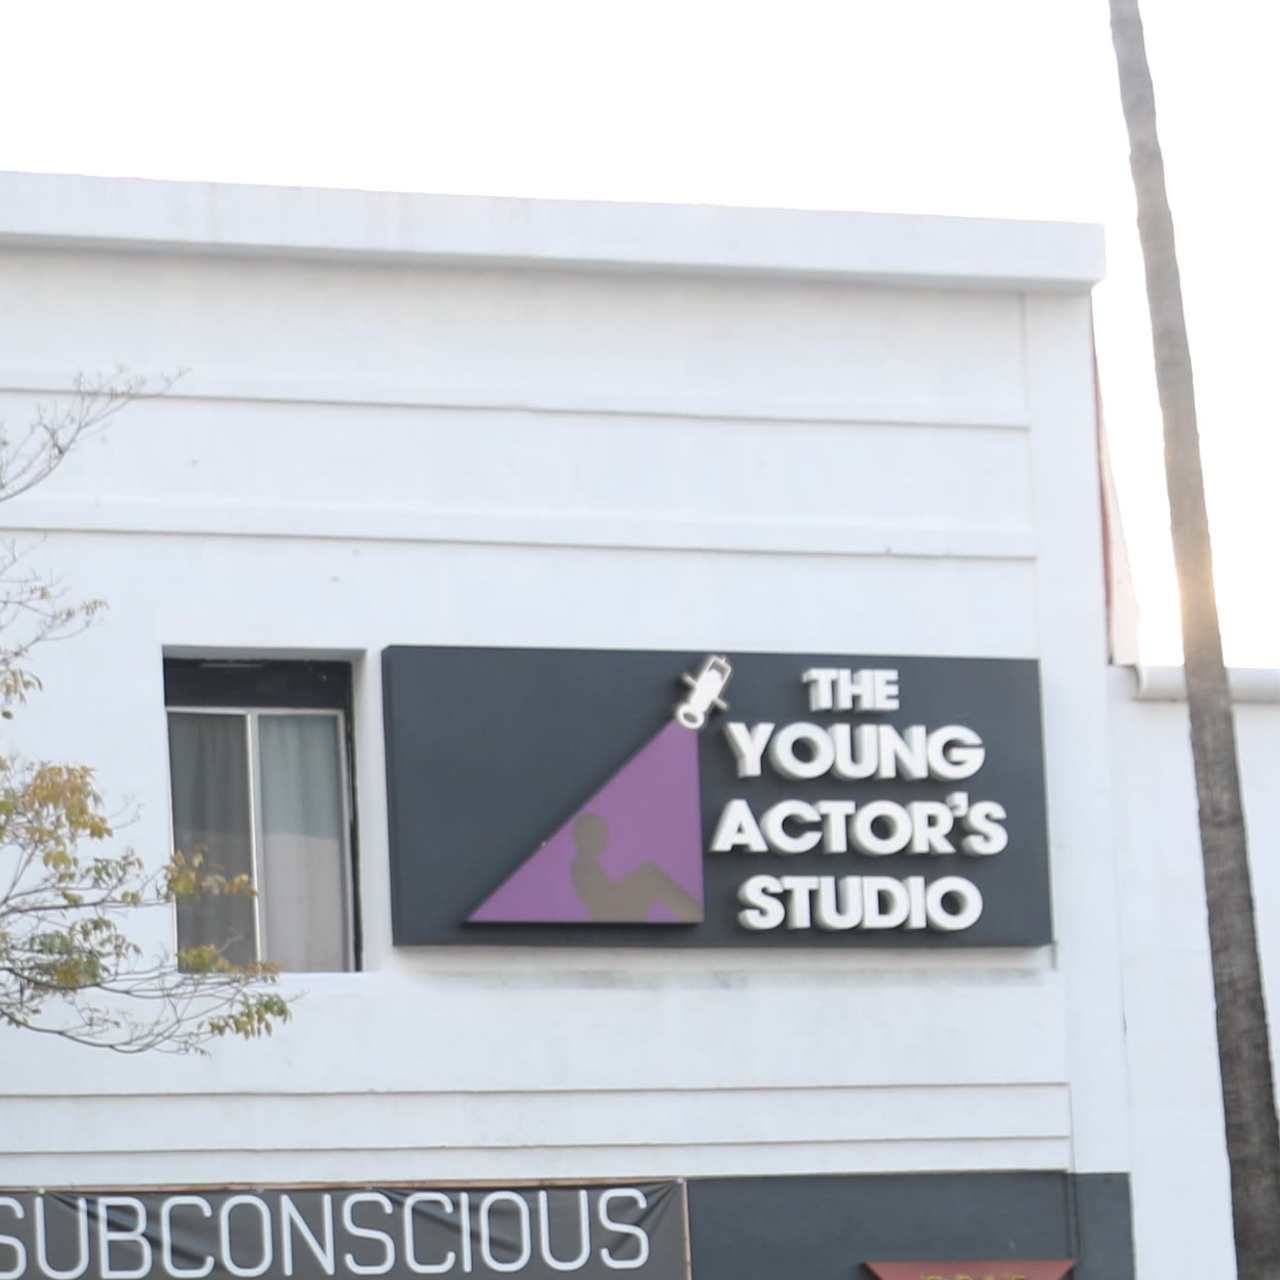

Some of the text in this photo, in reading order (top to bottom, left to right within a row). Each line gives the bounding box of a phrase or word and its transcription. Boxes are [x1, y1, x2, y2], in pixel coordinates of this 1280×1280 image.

[803, 667, 900, 712] THE
[726, 721, 986, 780] YOUNG
[709, 791, 1009, 856] ACTOR'S
[737, 874, 983, 932] STUDIO
